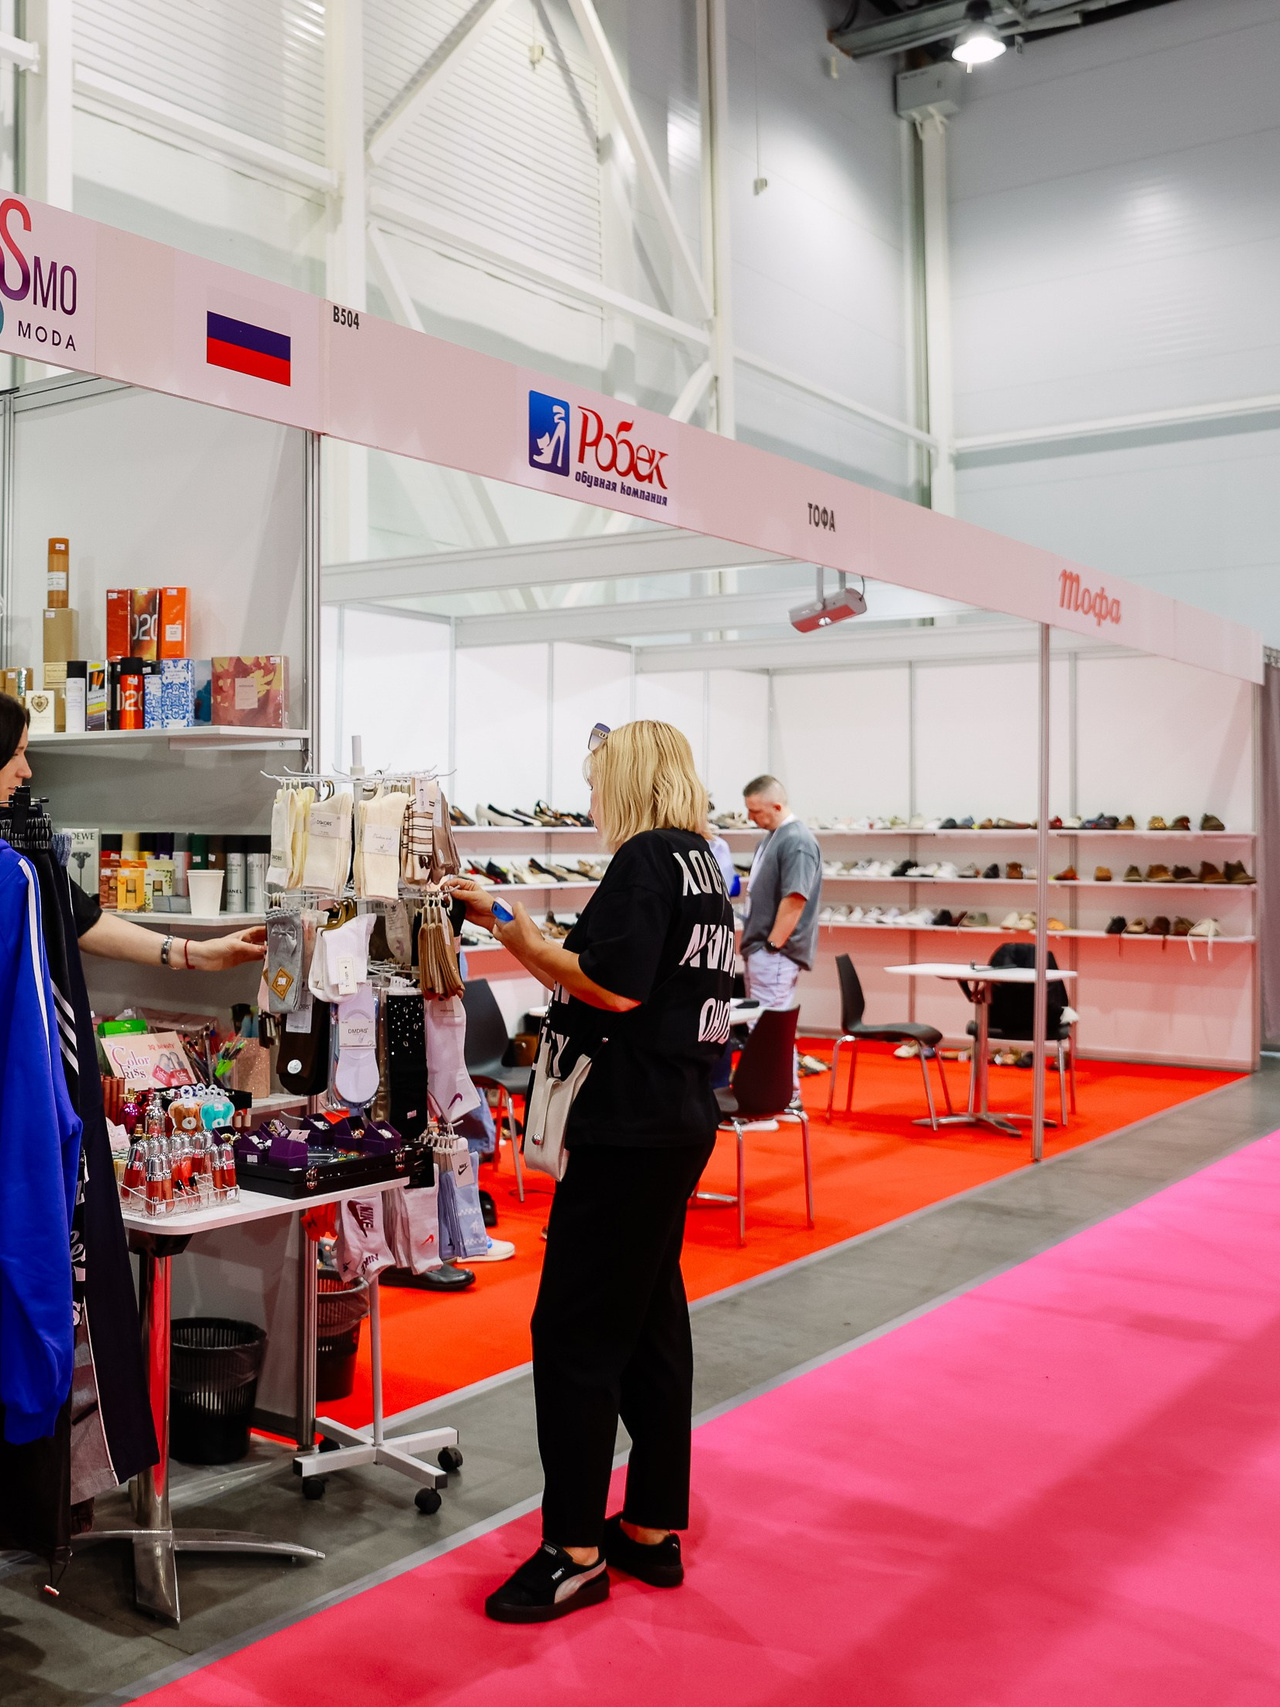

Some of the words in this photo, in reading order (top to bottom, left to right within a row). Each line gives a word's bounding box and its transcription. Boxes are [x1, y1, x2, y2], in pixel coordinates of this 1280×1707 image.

[18, 320, 77, 352] MODA
[577, 405, 669, 490] Робек
[574, 471, 618, 493] обувная
[619, 482, 668, 507] компания
[807, 502, 836, 533] ТОФА
[71, 832, 95, 840] OEWE
[359, 1206, 374, 1229] NIKE
[361, 1253, 379, 1275] NIKE
